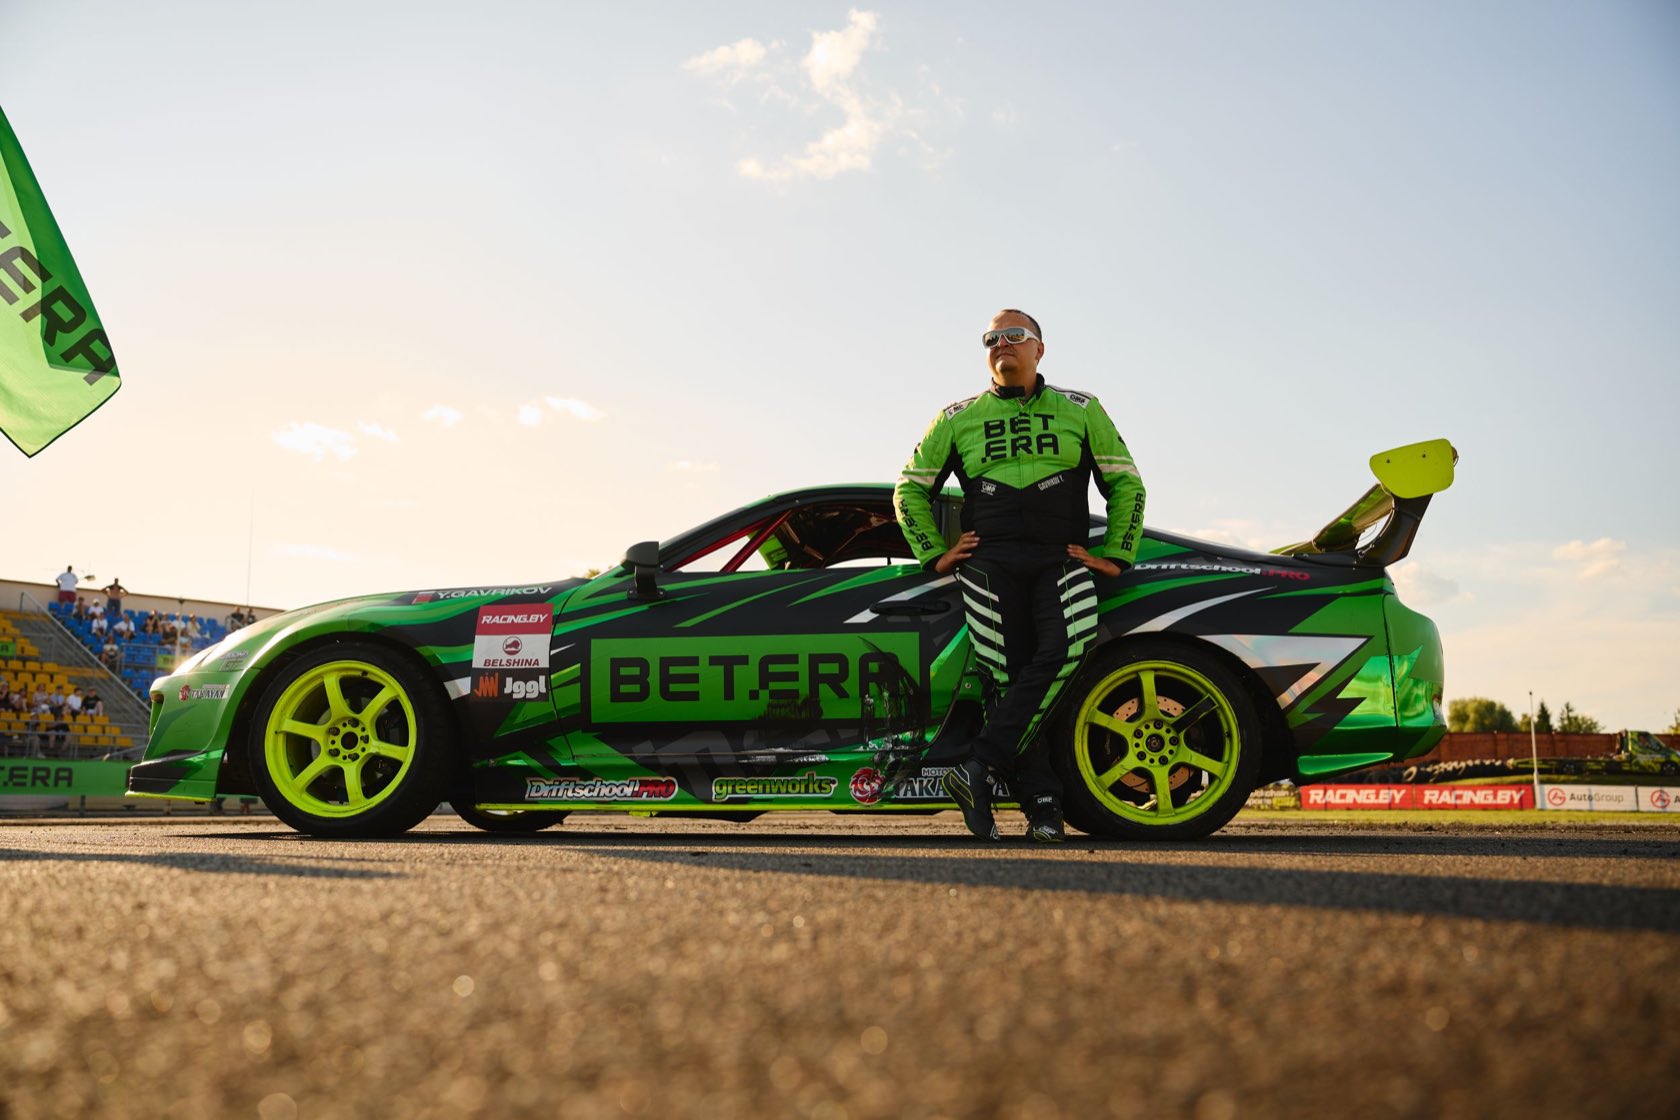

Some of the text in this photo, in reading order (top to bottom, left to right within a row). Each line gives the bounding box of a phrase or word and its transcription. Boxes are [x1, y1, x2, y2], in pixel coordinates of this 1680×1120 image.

[0, 221, 117, 386] ERA
[984, 412, 1055, 439] BET
[481, 613, 548, 625] RACING.BY
[483, 658, 540, 667] BELSHINA
[922, 767, 950, 776] MOTO
[714, 773, 833, 799] greenworks
[1308, 789, 1406, 805] RACING.BY
[1424, 789, 1525, 806] RACING.BY
